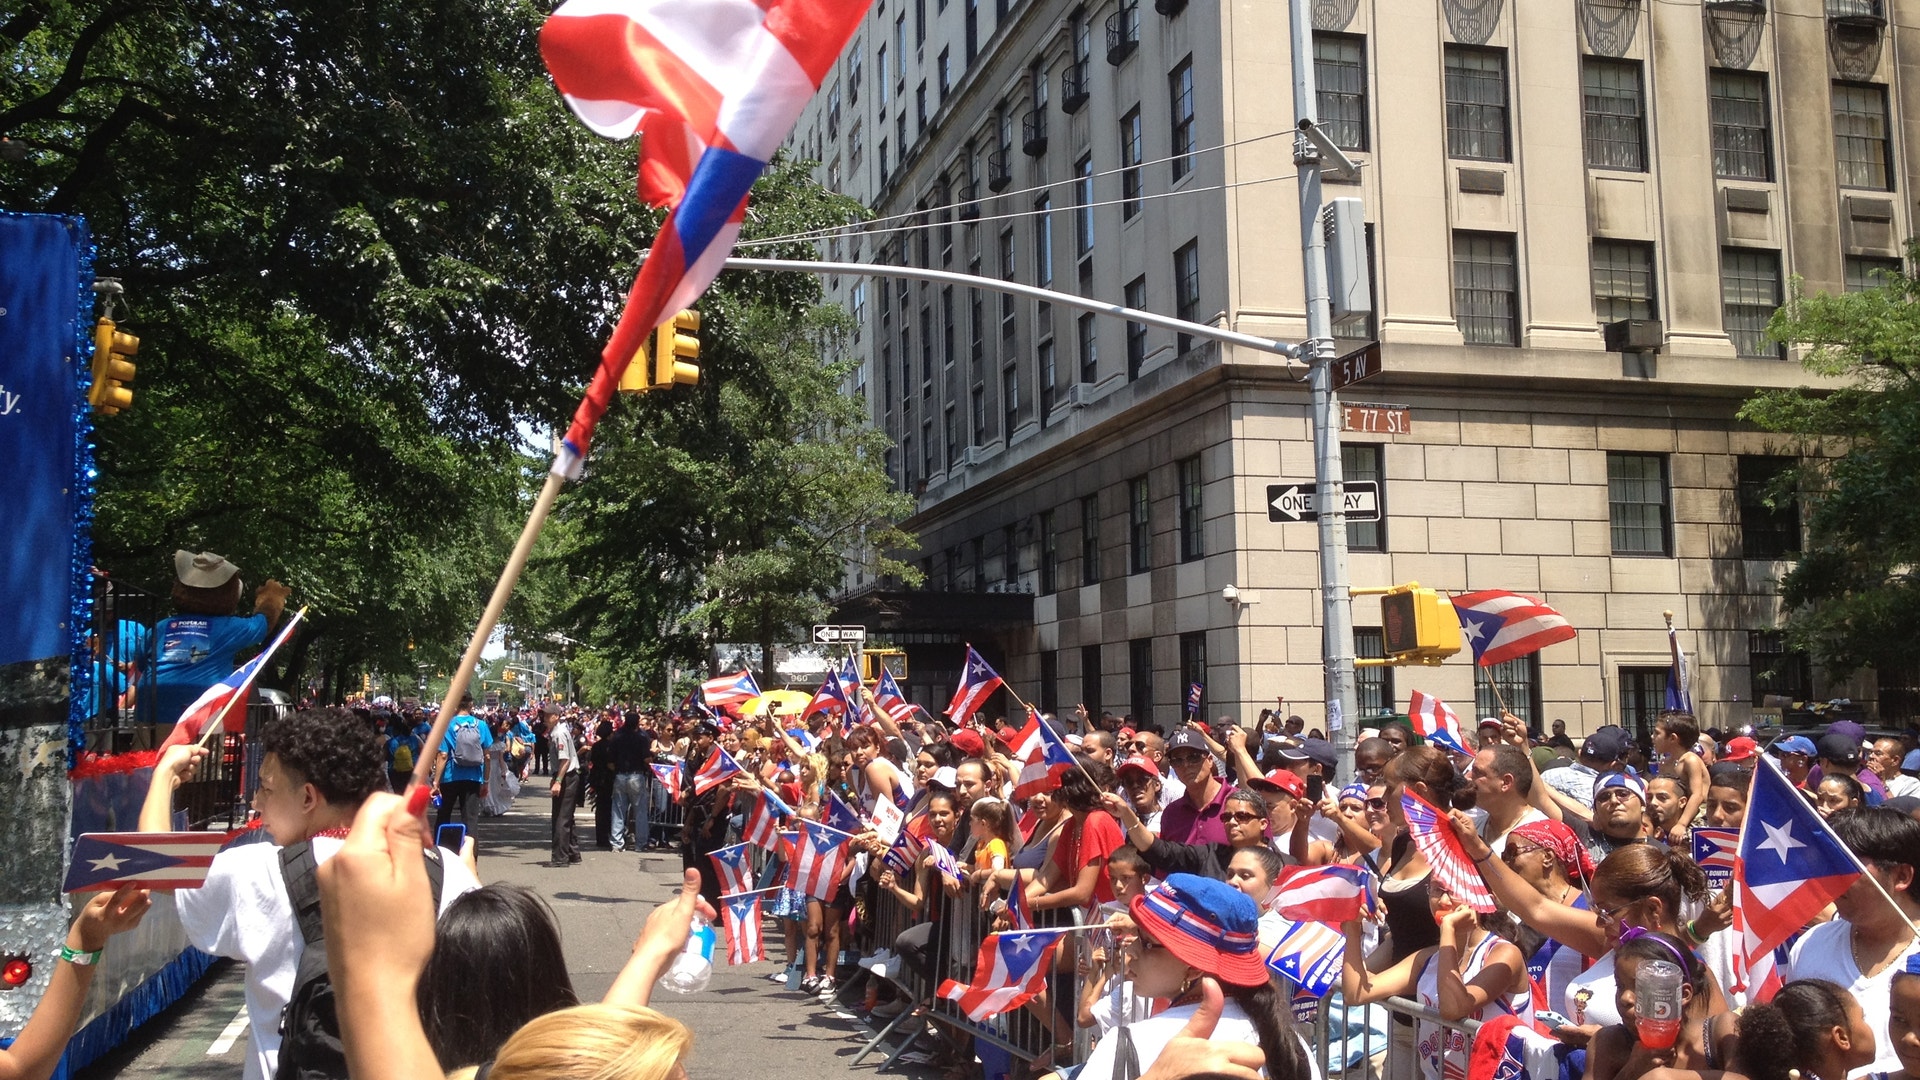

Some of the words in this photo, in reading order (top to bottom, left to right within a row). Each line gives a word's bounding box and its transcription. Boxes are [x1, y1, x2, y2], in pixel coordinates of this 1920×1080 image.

[1343, 361, 1351, 384] 5
[1354, 353, 1367, 380] AV
[1344, 408, 1354, 430] E
[1360, 409, 1378, 432] 77
[1387, 410, 1403, 433] ST
[1282, 495, 1312, 511] ONE
[1344, 494, 1362, 509] AY
[790, 674, 808, 682] 960
